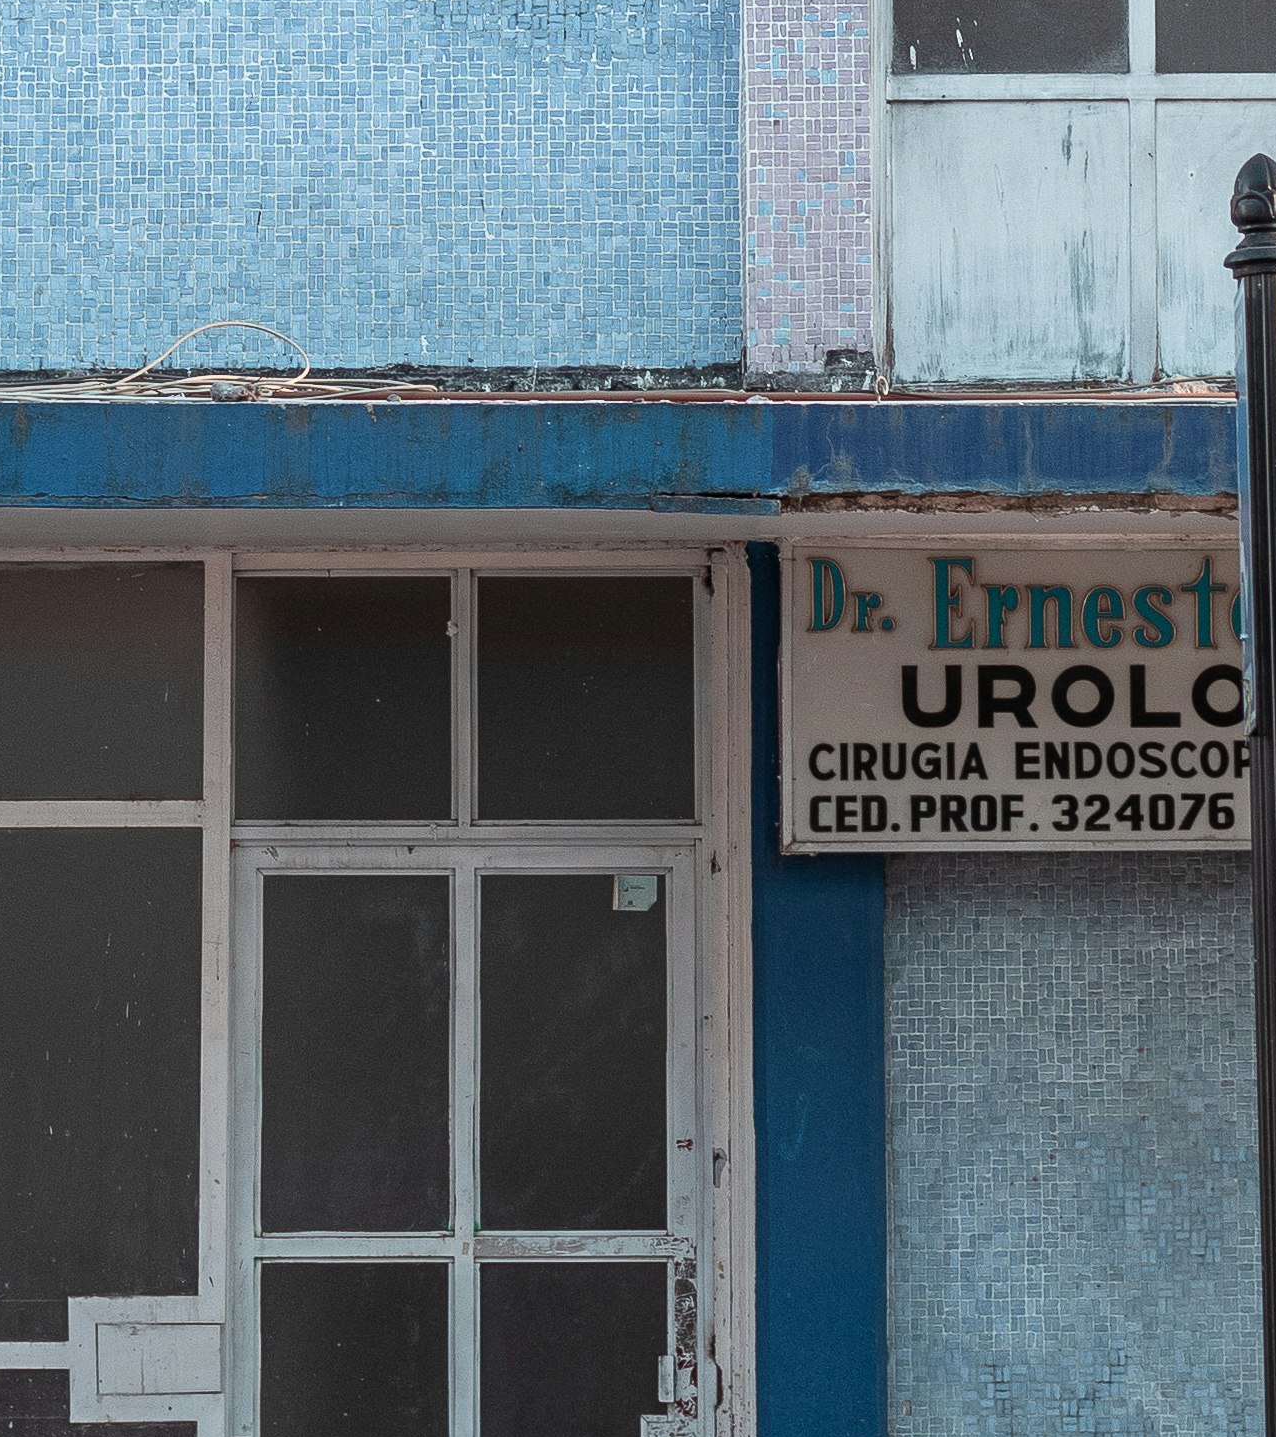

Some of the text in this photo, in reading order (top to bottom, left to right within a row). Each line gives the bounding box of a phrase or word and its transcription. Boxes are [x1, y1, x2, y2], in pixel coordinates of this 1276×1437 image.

[808, 556, 896, 634] Dr.
[809, 742, 988, 781] CIRUGIA
[1051, 792, 1235, 830] 324076
